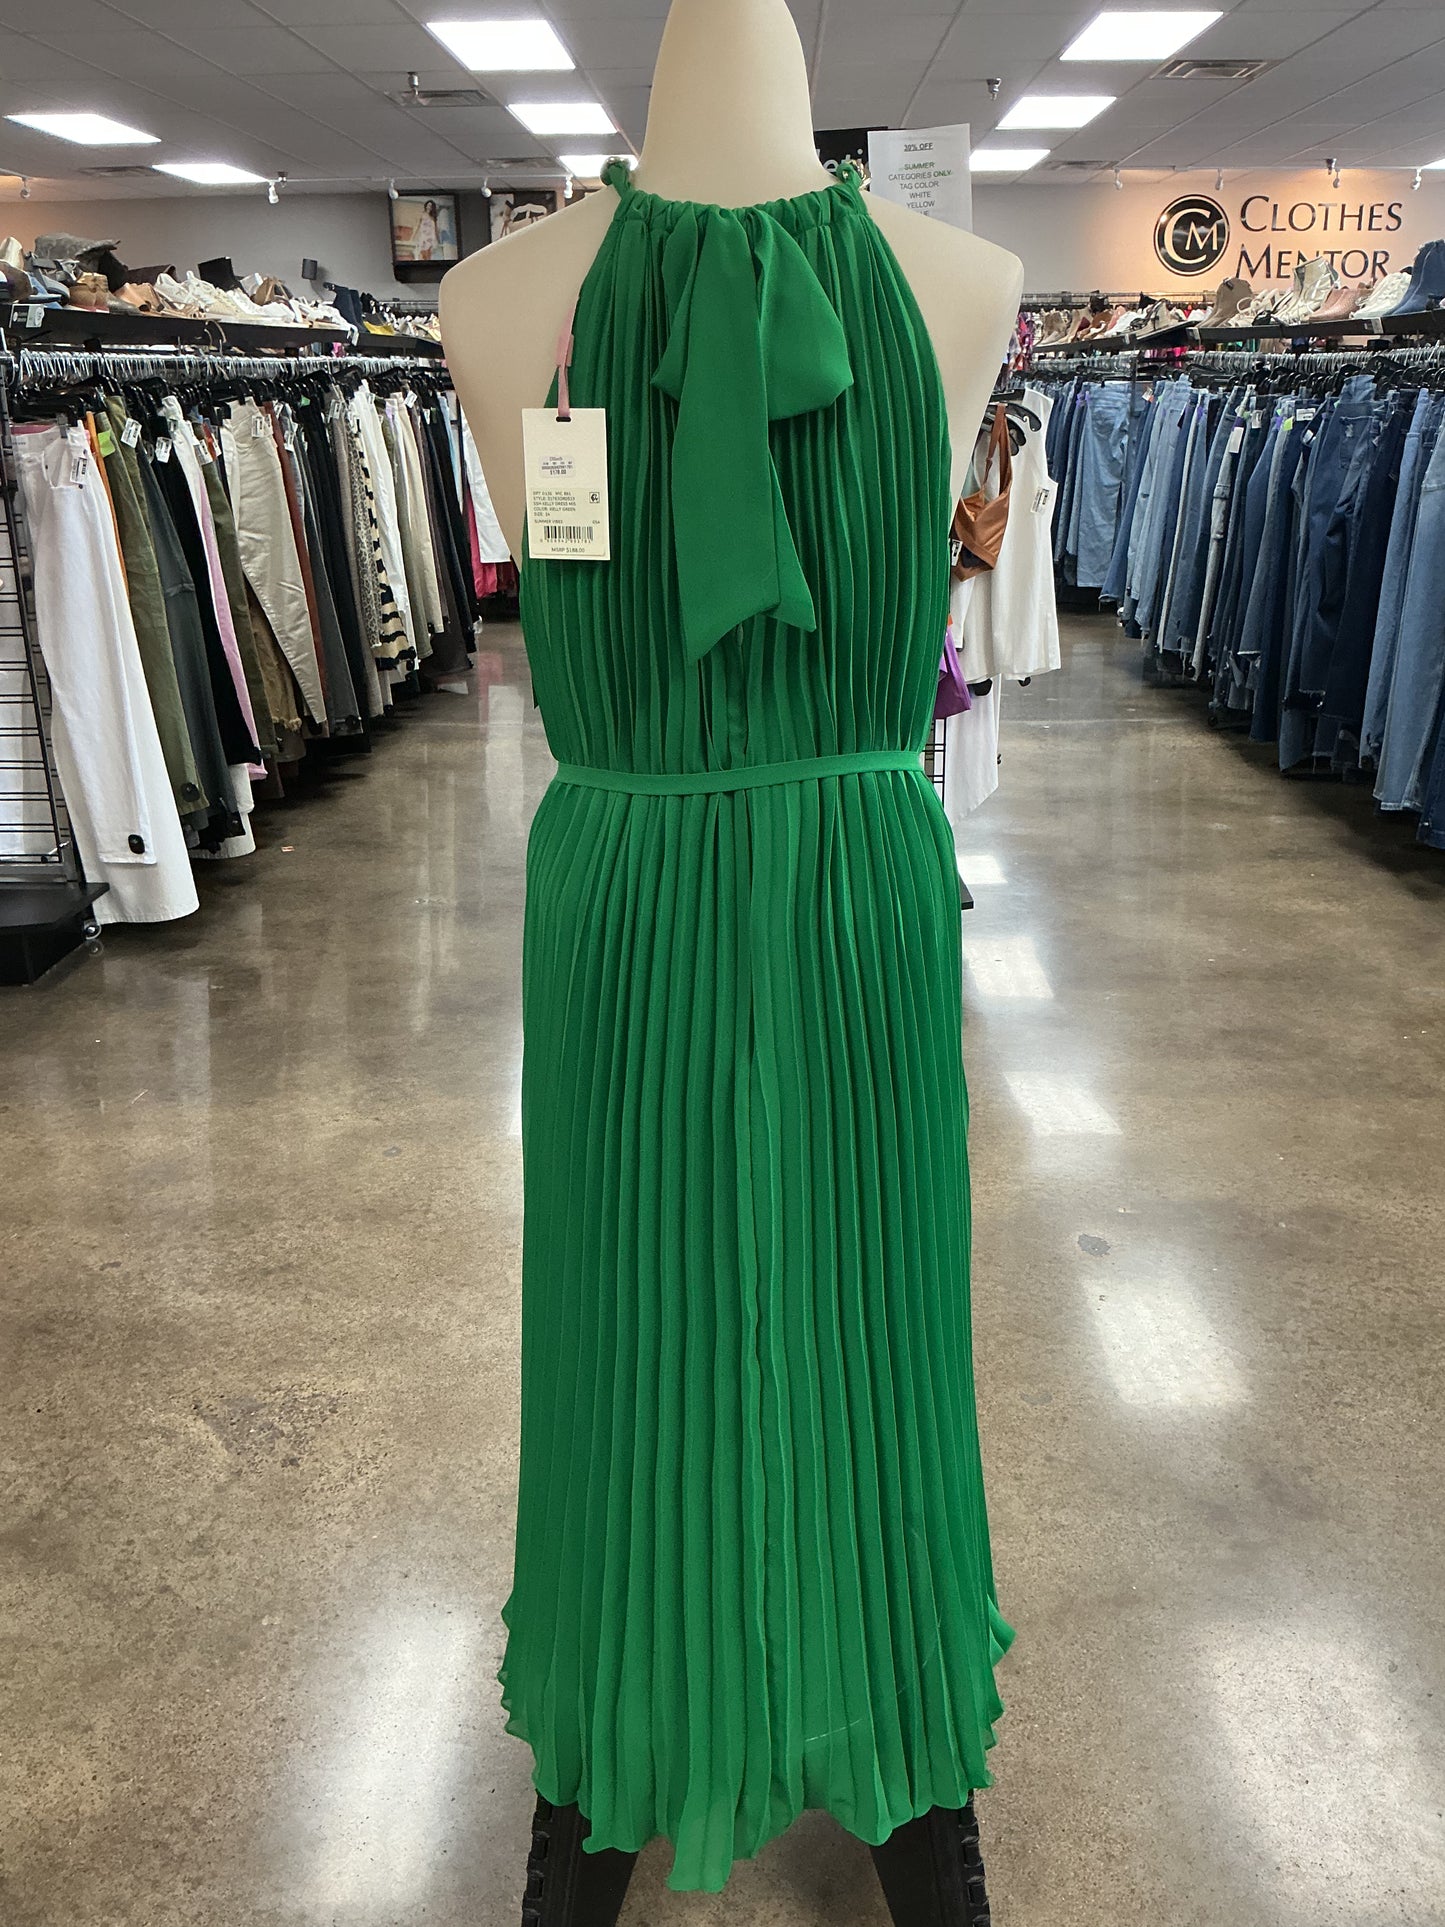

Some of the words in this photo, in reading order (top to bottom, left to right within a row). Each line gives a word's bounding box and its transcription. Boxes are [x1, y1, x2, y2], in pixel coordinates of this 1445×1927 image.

[919, 142, 934, 151] OFF
[904, 162, 935, 170] SUMMER
[888, 171, 932, 181] CATEGORIES
[914, 181, 939, 189] COLOR
[907, 200, 935, 209] YELLOW
[1240, 195, 1403, 232] CLOTHES
